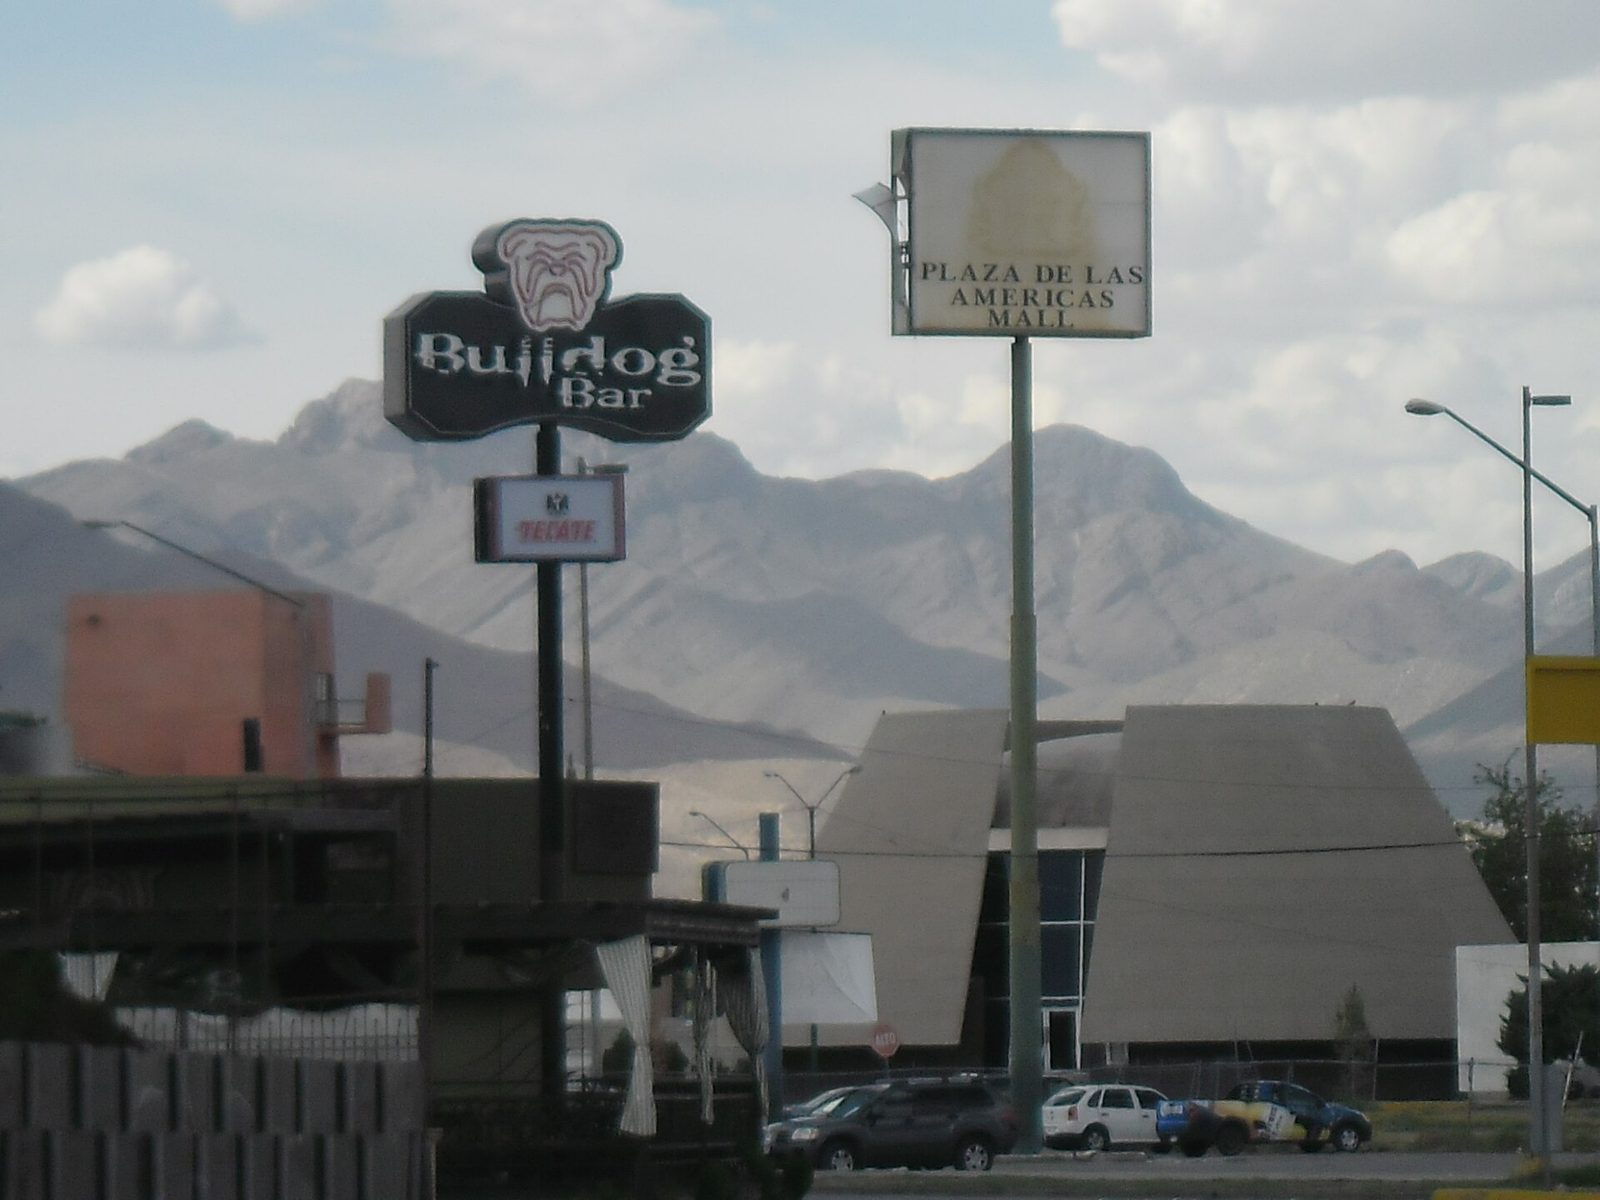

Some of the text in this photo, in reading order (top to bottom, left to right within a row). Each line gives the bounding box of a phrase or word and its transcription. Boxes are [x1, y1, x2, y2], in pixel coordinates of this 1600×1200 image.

[922, 262, 1144, 285] PLAZA DE LAS
[951, 287, 1115, 308] AMERICAS
[988, 309, 1074, 329] MALL
[561, 376, 652, 409] Bar
[519, 521, 596, 542] TECATE
